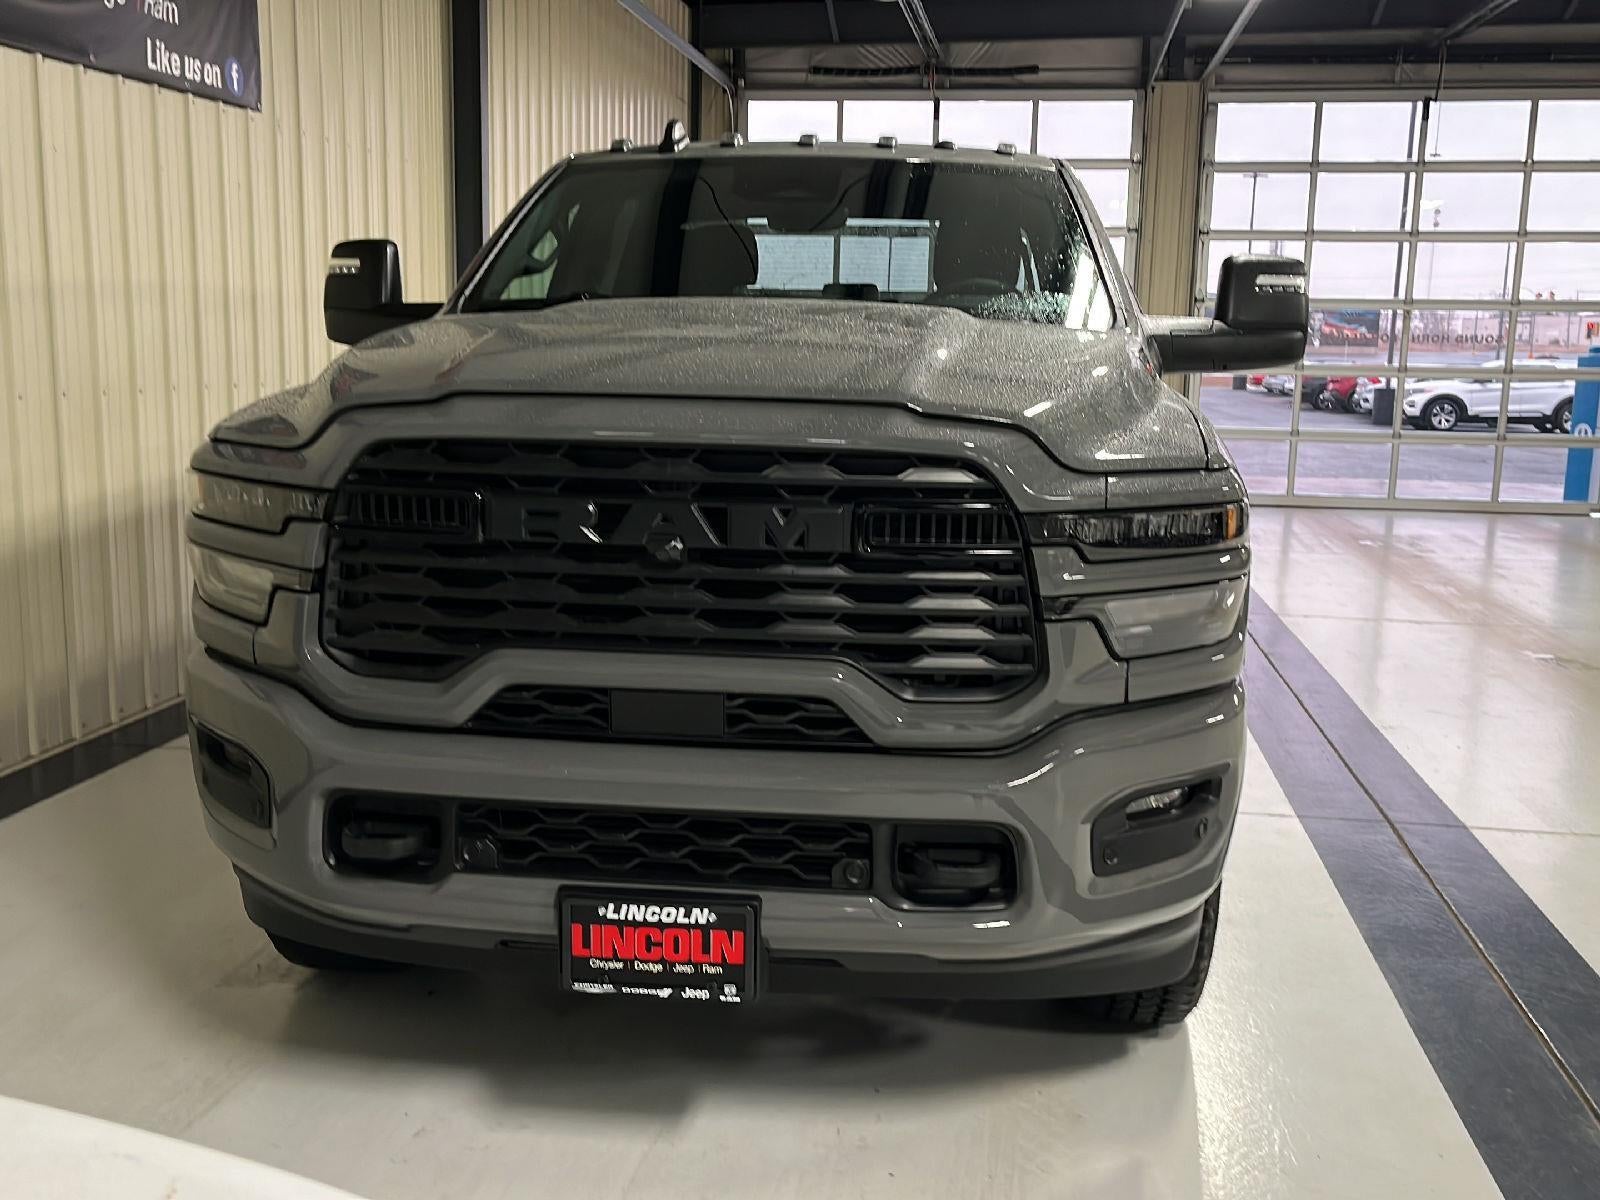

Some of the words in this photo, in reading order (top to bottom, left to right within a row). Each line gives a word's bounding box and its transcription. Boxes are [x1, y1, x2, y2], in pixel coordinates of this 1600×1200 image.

[146, 37, 181, 77] Like
[184, 55, 201, 83] us
[204, 62, 222, 88] on
[491, 498, 851, 551] RAM
[606, 903, 710, 924] LINCOLN
[571, 923, 745, 965] LINCOLN
[589, 958, 624, 970] Chrysler
[634, 960, 663, 973] Dodge
[672, 962, 695, 974] Jeep
[702, 964, 723, 974] Ram
[681, 986, 710, 1001] Jeep
